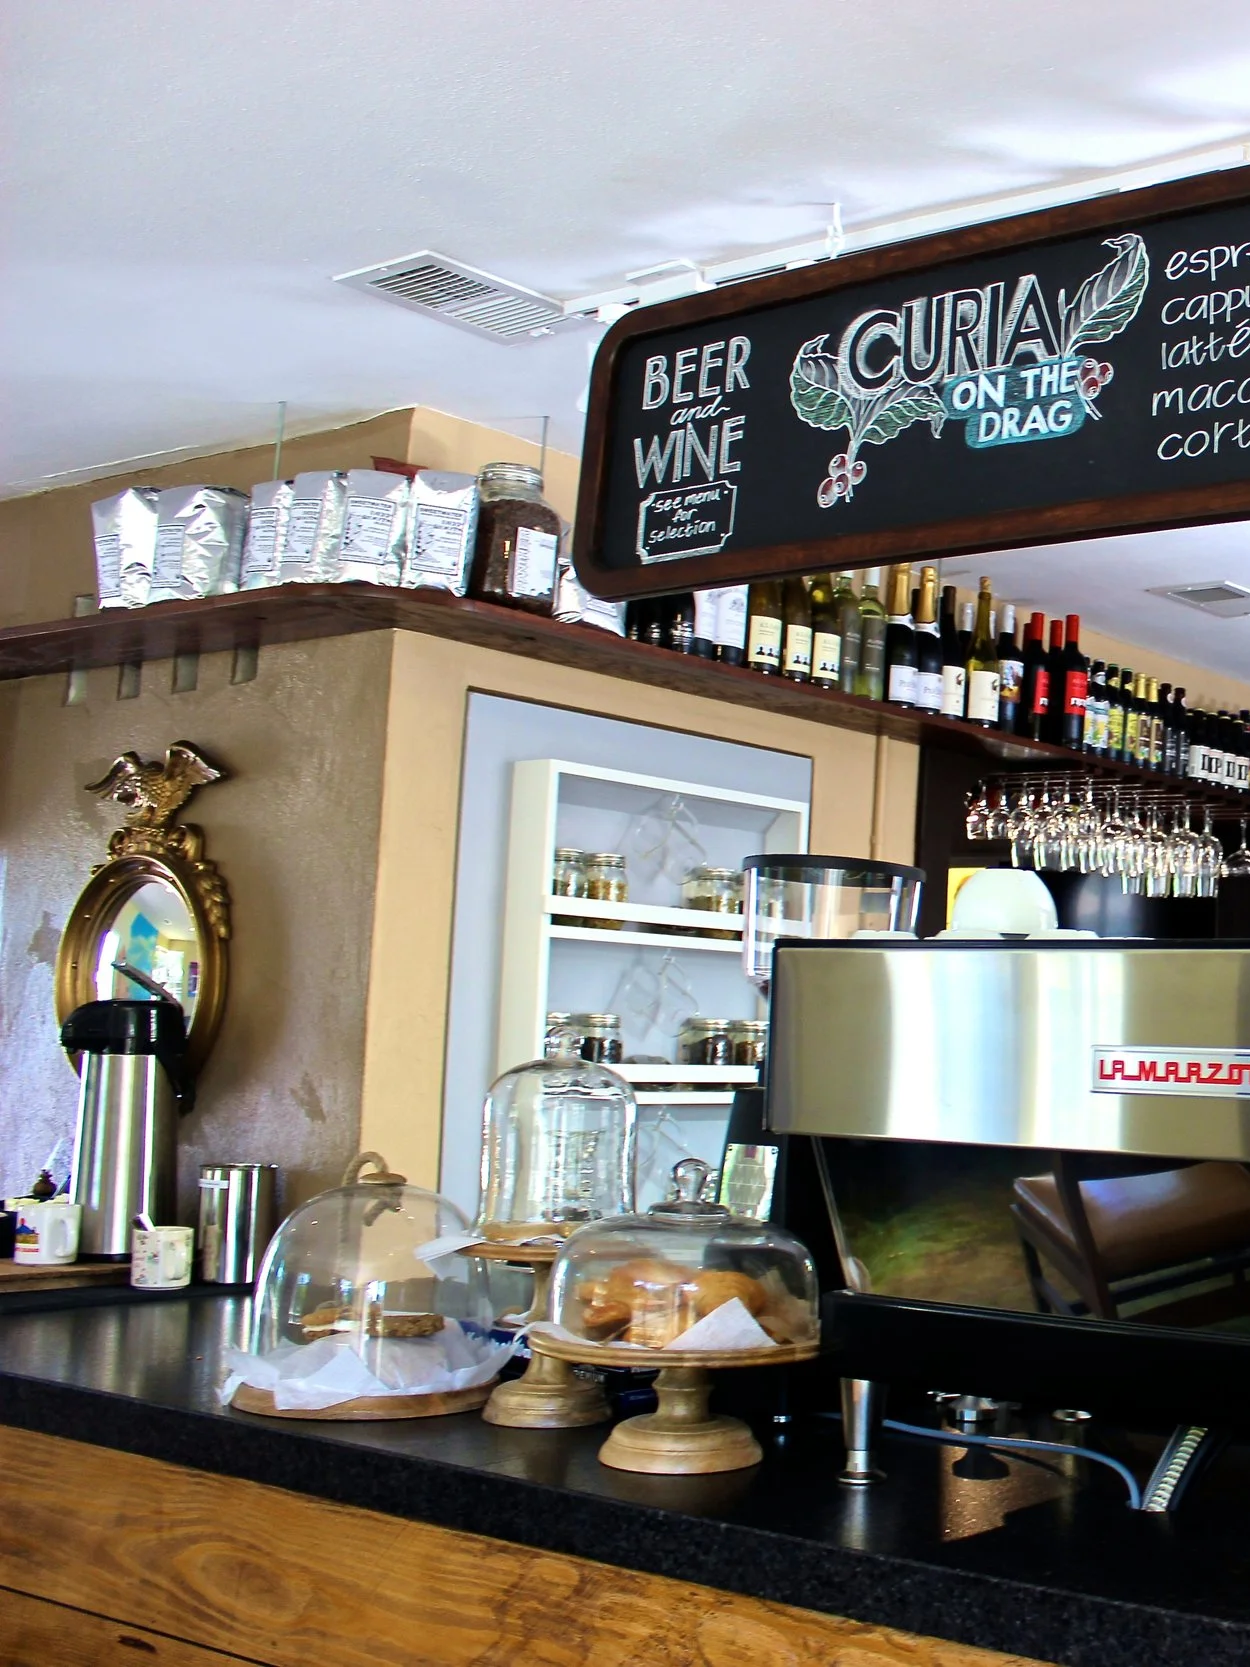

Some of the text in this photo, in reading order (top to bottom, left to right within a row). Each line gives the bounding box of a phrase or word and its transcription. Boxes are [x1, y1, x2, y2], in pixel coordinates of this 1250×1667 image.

[837, 273, 1061, 400] CURIA
[642, 336, 751, 410] BEER
[951, 361, 1078, 410] ON THE
[669, 396, 730, 426] and
[976, 399, 1075, 444] DRAG
[633, 416, 747, 489] WINE
[653, 488, 721, 513] see menu
[671, 508, 698, 523] for
